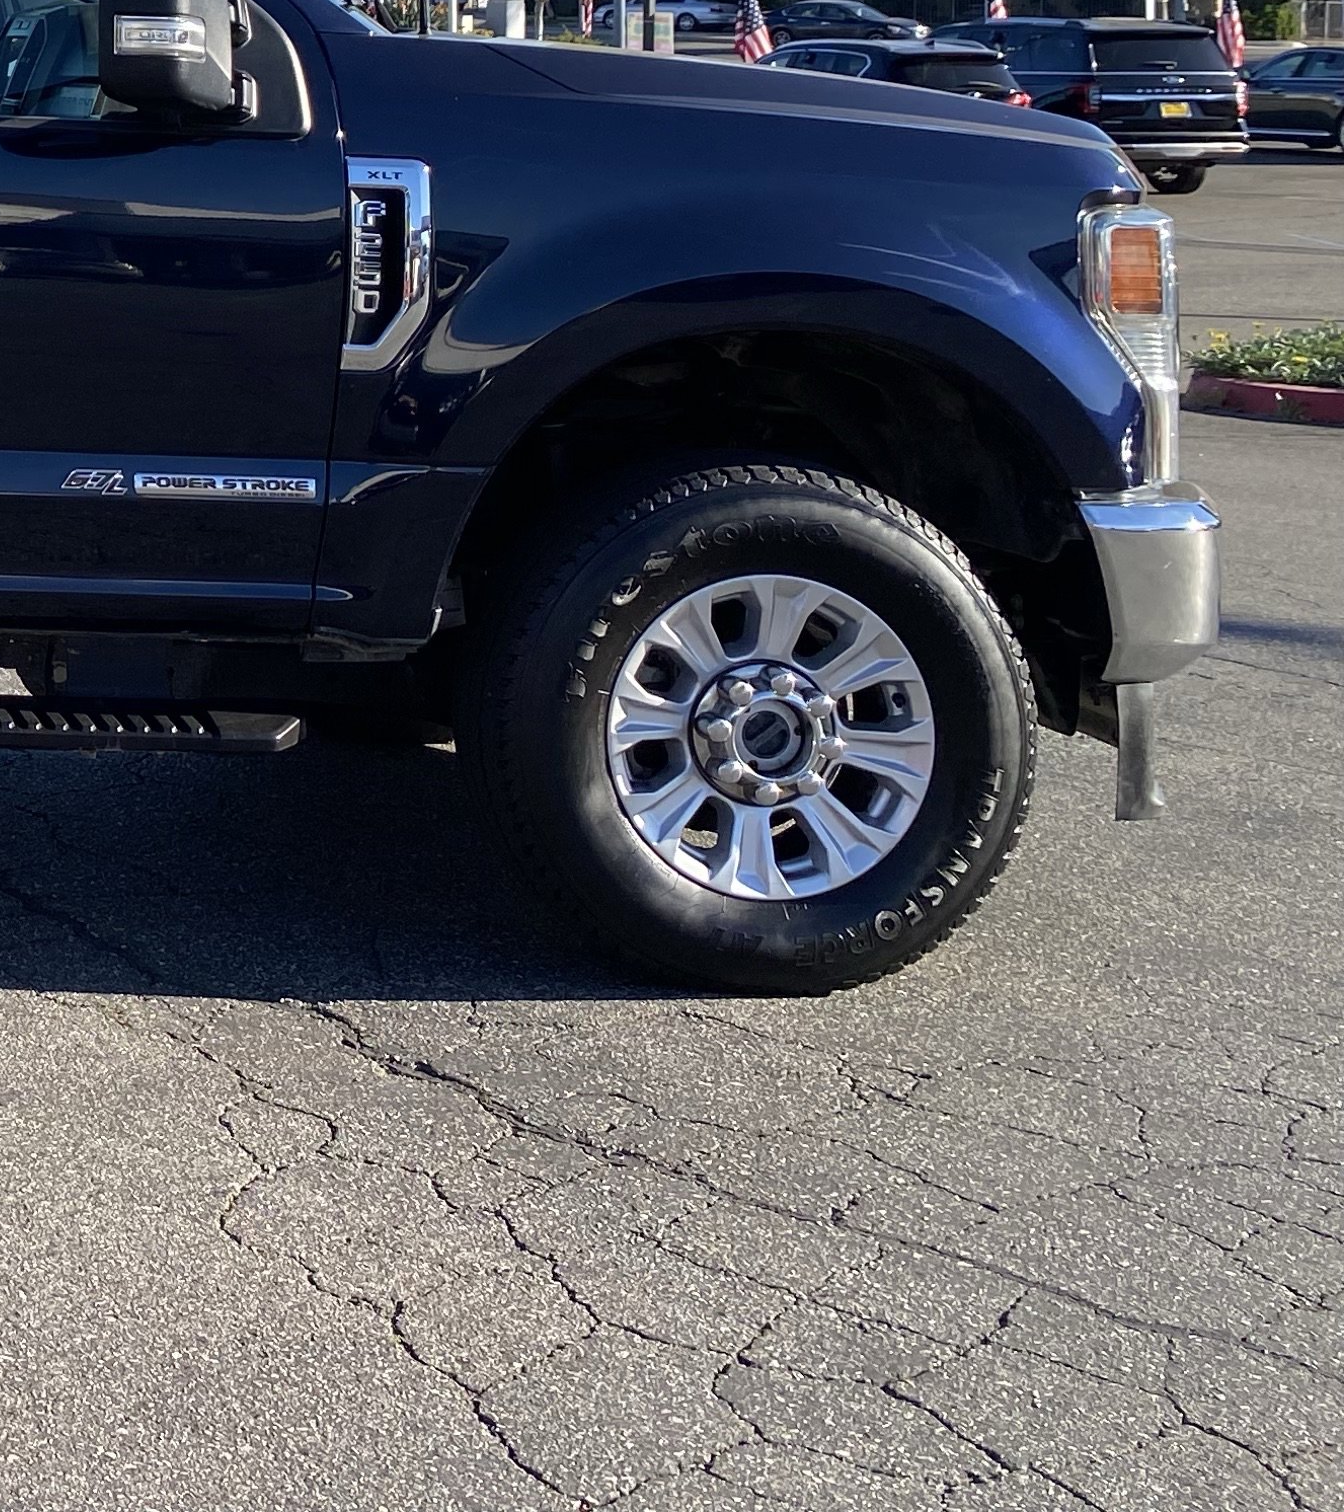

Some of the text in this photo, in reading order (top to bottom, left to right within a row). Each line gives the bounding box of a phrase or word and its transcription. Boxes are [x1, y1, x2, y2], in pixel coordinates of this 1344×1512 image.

[367, 170, 403, 180] XLT
[141, 475, 217, 489] POWER
[222, 478, 310, 492] STROKE
